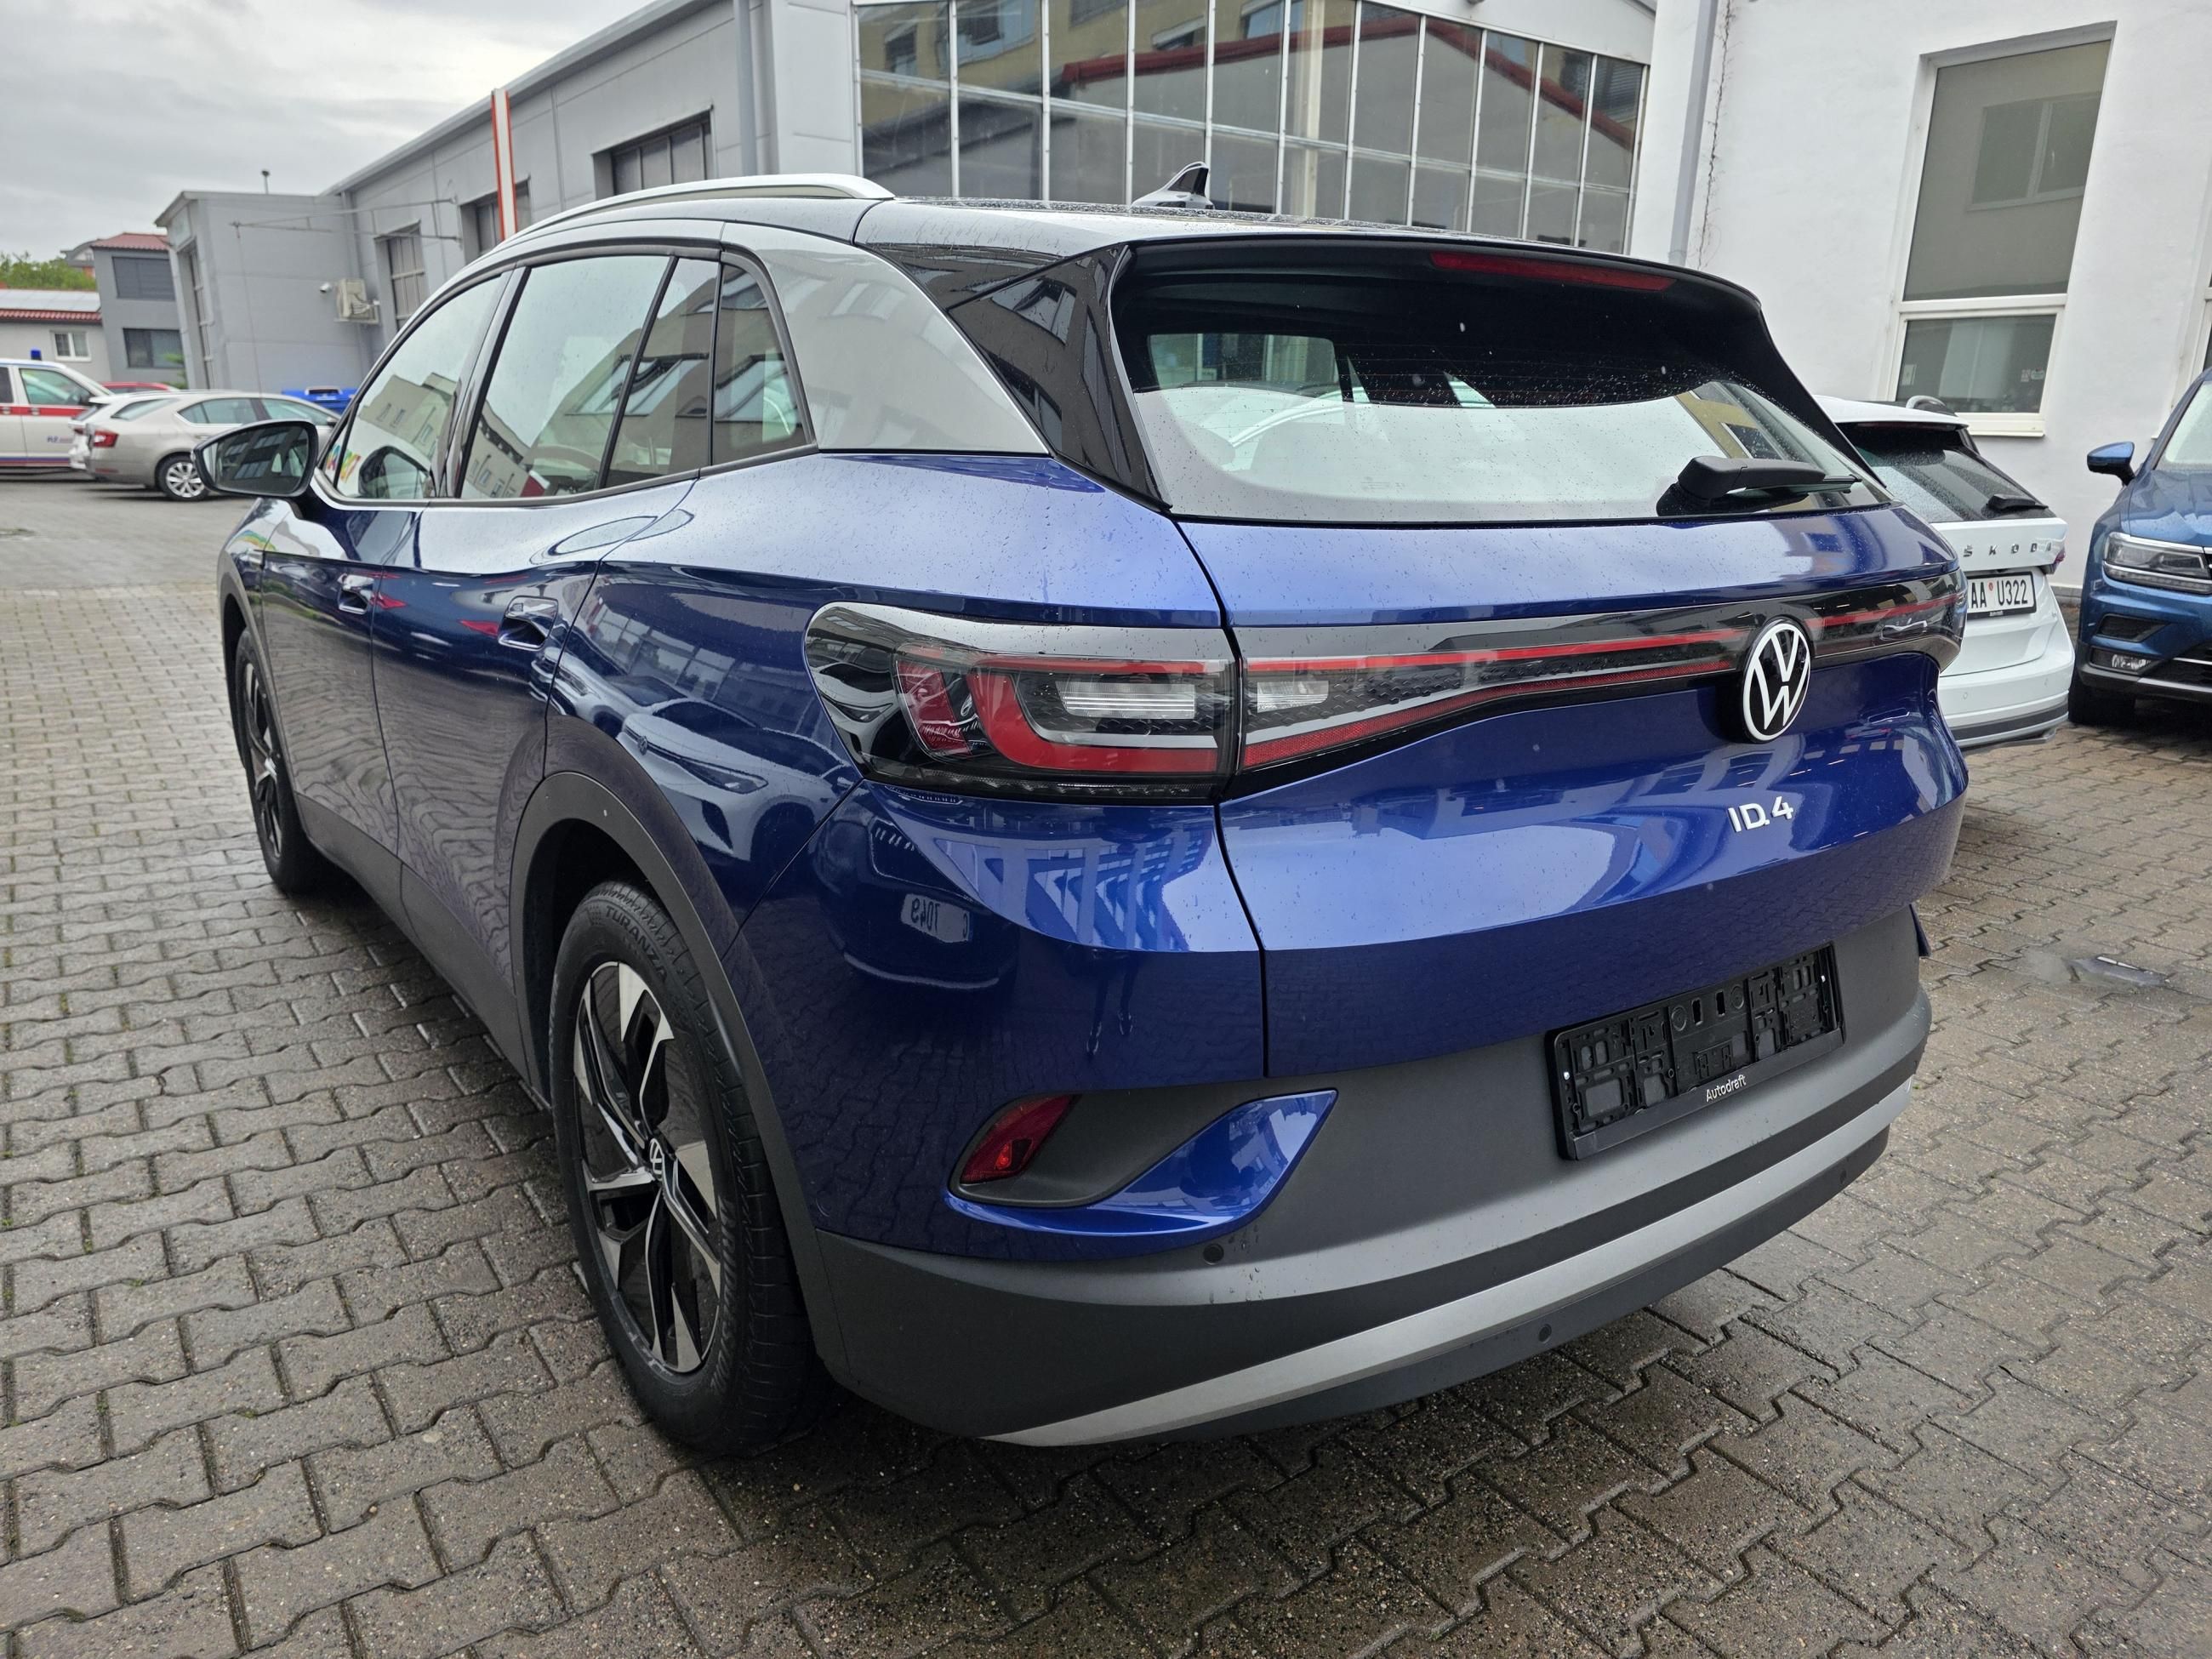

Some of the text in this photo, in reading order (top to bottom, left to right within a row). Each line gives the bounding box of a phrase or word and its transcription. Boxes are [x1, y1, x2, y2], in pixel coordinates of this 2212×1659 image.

[1971, 579, 2028, 608] AA U322
[1728, 796, 1794, 832] ID.4
[1706, 1074, 1747, 1103] Autodraft
